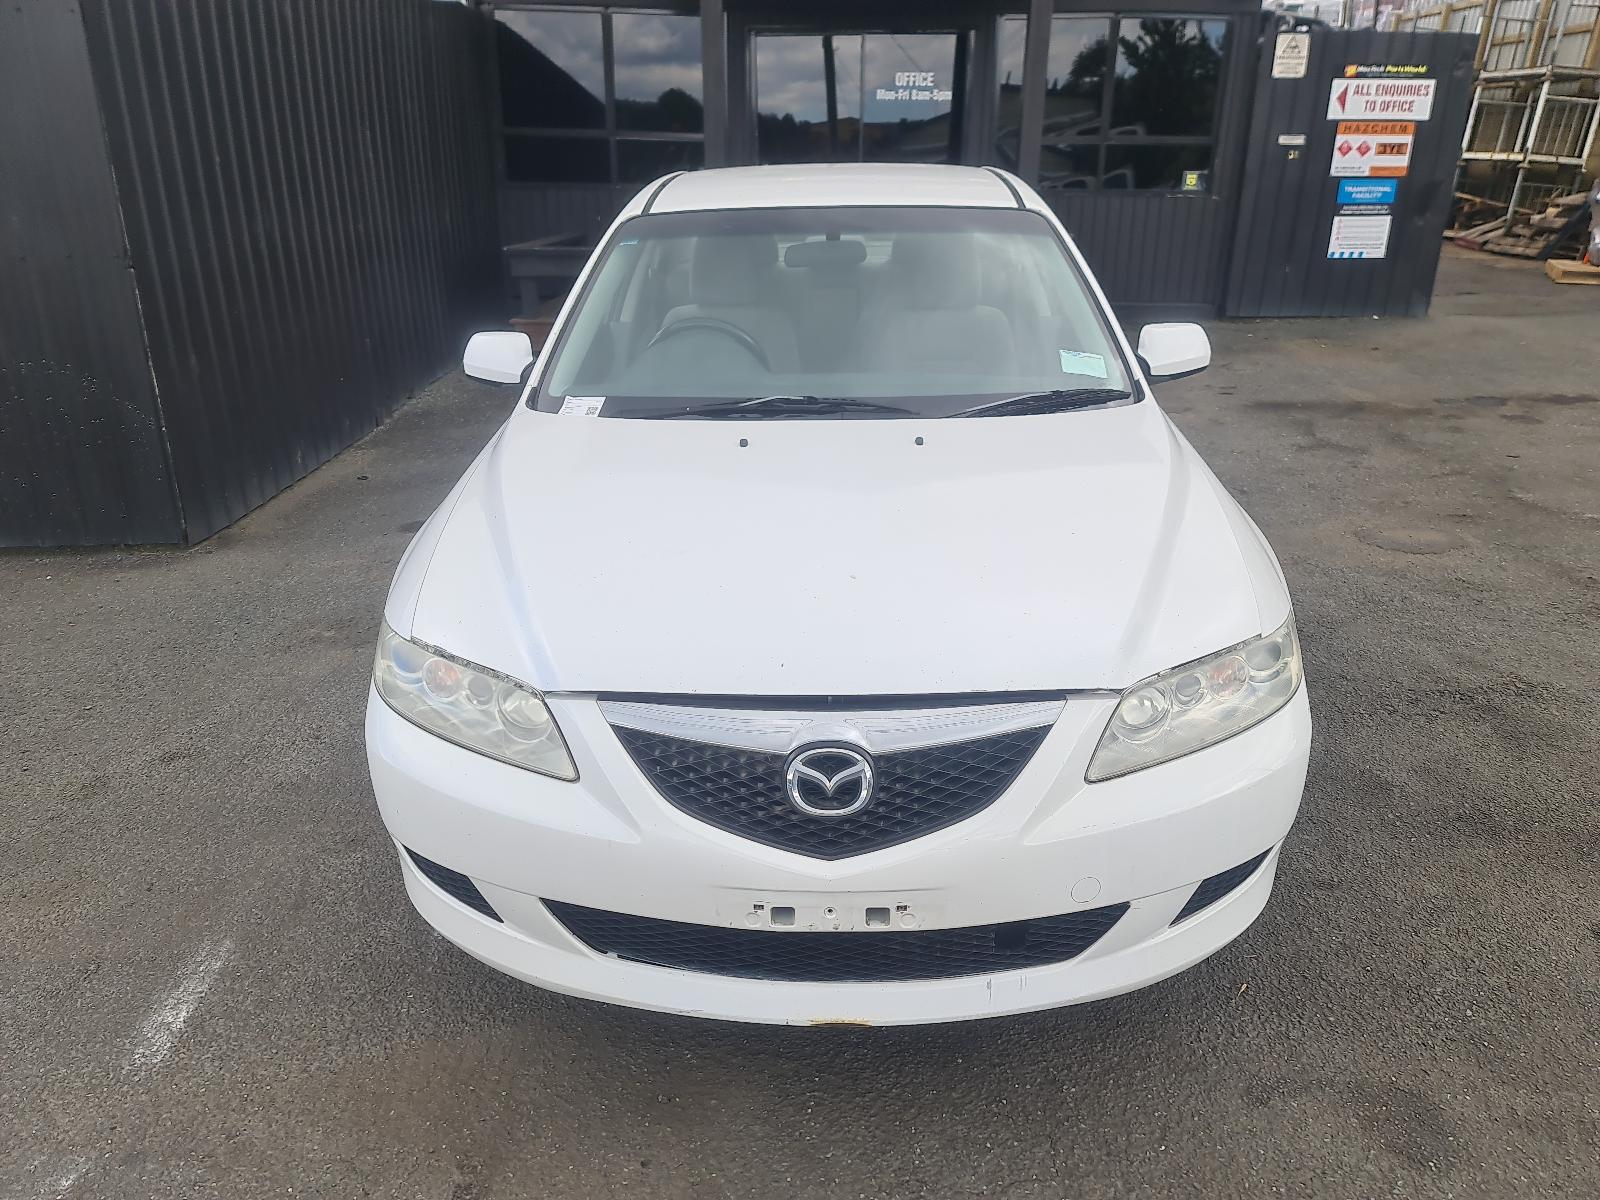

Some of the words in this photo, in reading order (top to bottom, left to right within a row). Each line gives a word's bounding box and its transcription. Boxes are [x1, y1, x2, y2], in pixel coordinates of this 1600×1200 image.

[895, 72, 936, 87] OFFICE
[876, 89, 910, 101] Mon-Fri
[1353, 83, 1372, 96] ALL
[1375, 84, 1430, 98] ENQUIRIES
[1364, 100, 1376, 113] TO
[1379, 100, 1416, 113] OFFICE
[1343, 124, 1408, 133] HAZCHEM
